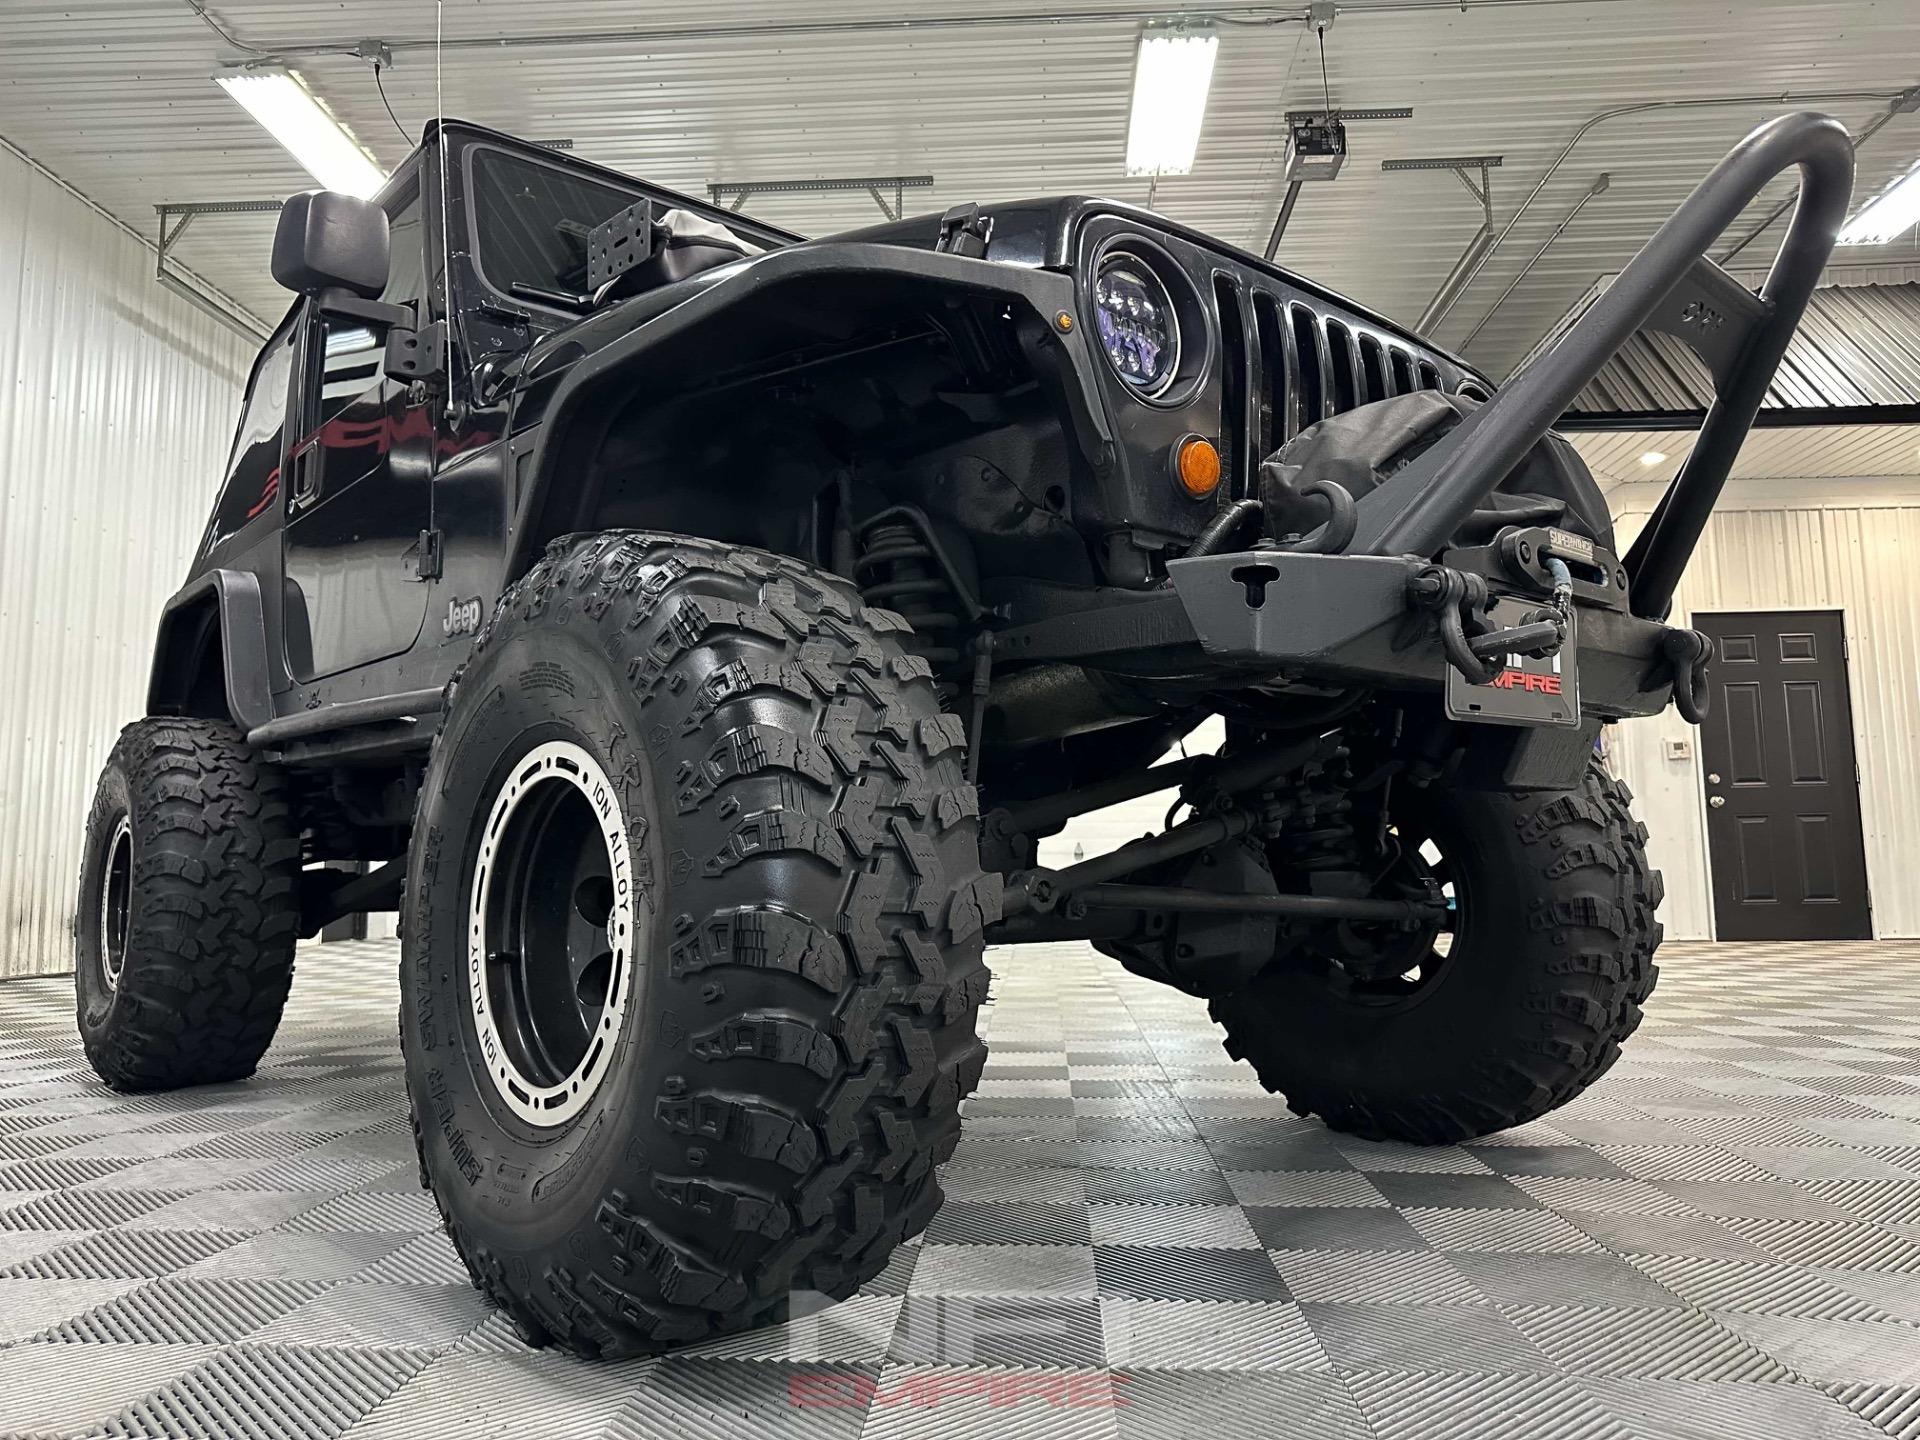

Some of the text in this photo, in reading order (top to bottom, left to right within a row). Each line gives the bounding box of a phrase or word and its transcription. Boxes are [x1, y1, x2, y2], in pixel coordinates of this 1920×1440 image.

[442, 599, 481, 635] Jeep
[1475, 670, 1562, 695] MPIRE
[592, 780, 629, 912] ION ALLOY
[470, 944, 497, 1066] ION ALLOY
[425, 1067, 484, 1187] SUPER
